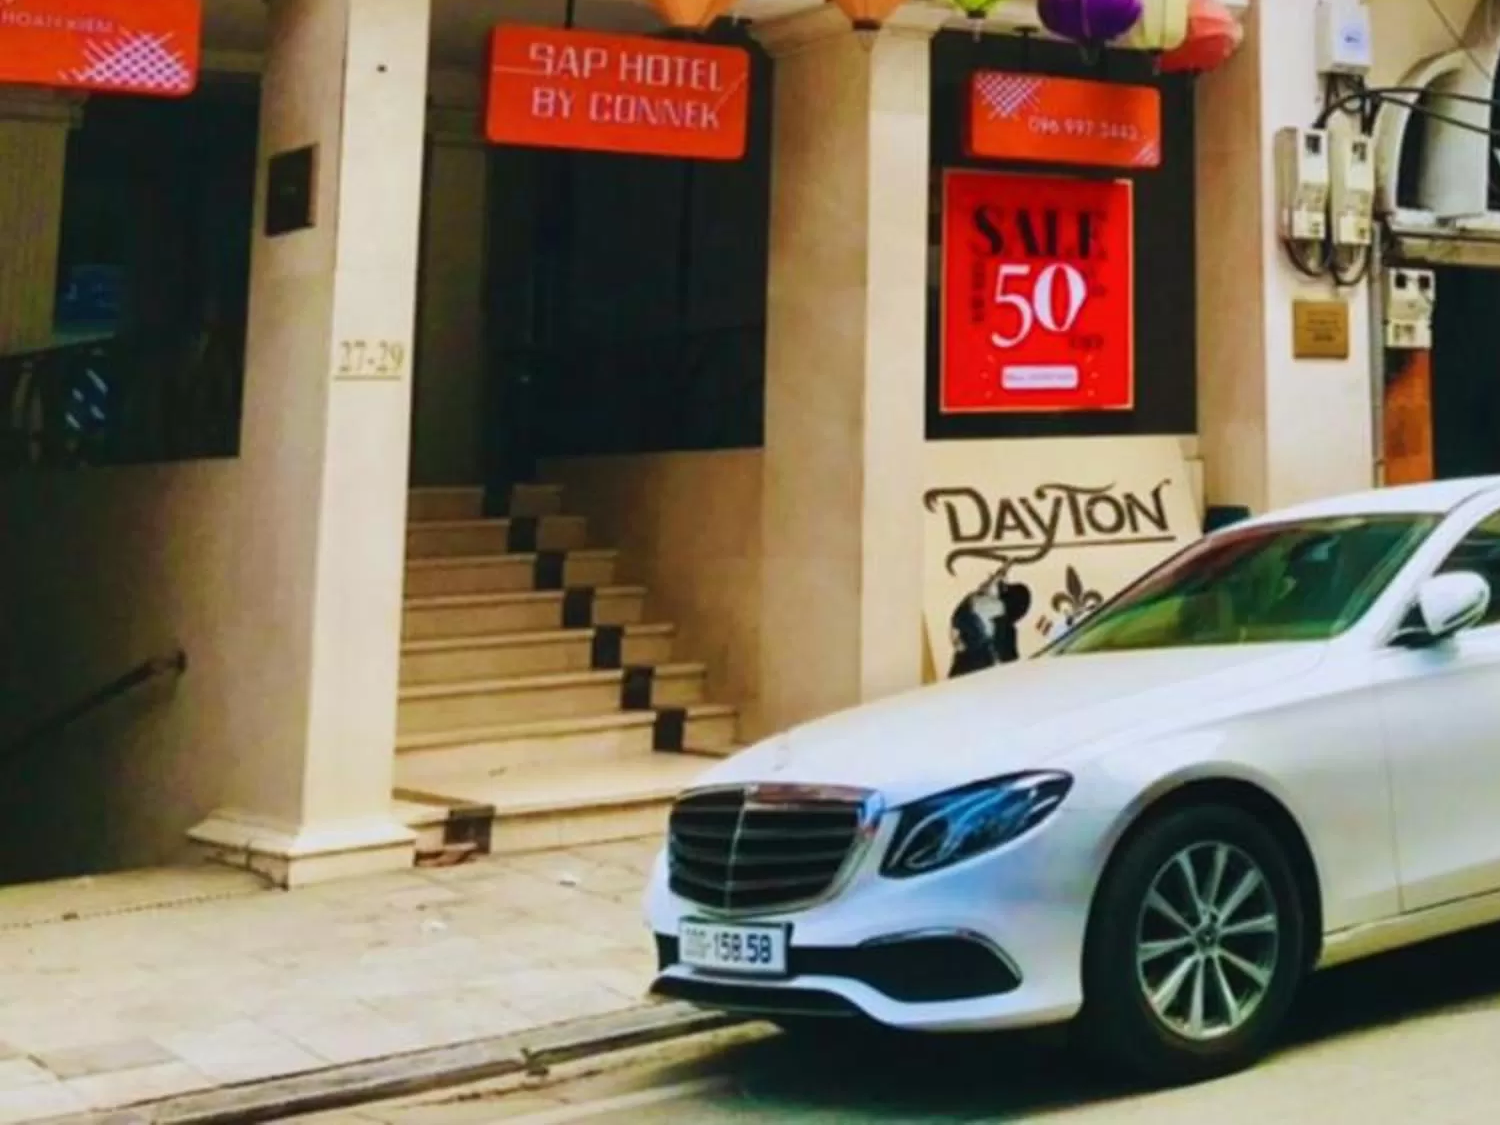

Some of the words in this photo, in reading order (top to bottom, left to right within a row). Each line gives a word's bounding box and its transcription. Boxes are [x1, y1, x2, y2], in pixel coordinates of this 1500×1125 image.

[529, 42, 608, 79] SAP
[620, 51, 722, 92] HOTEL
[532, 87, 575, 119] BY
[590, 92, 720, 130] CONNEK
[972, 205, 1108, 258] SALE
[339, 339, 405, 375] 27-29
[923, 478, 1175, 576] DAYTON
